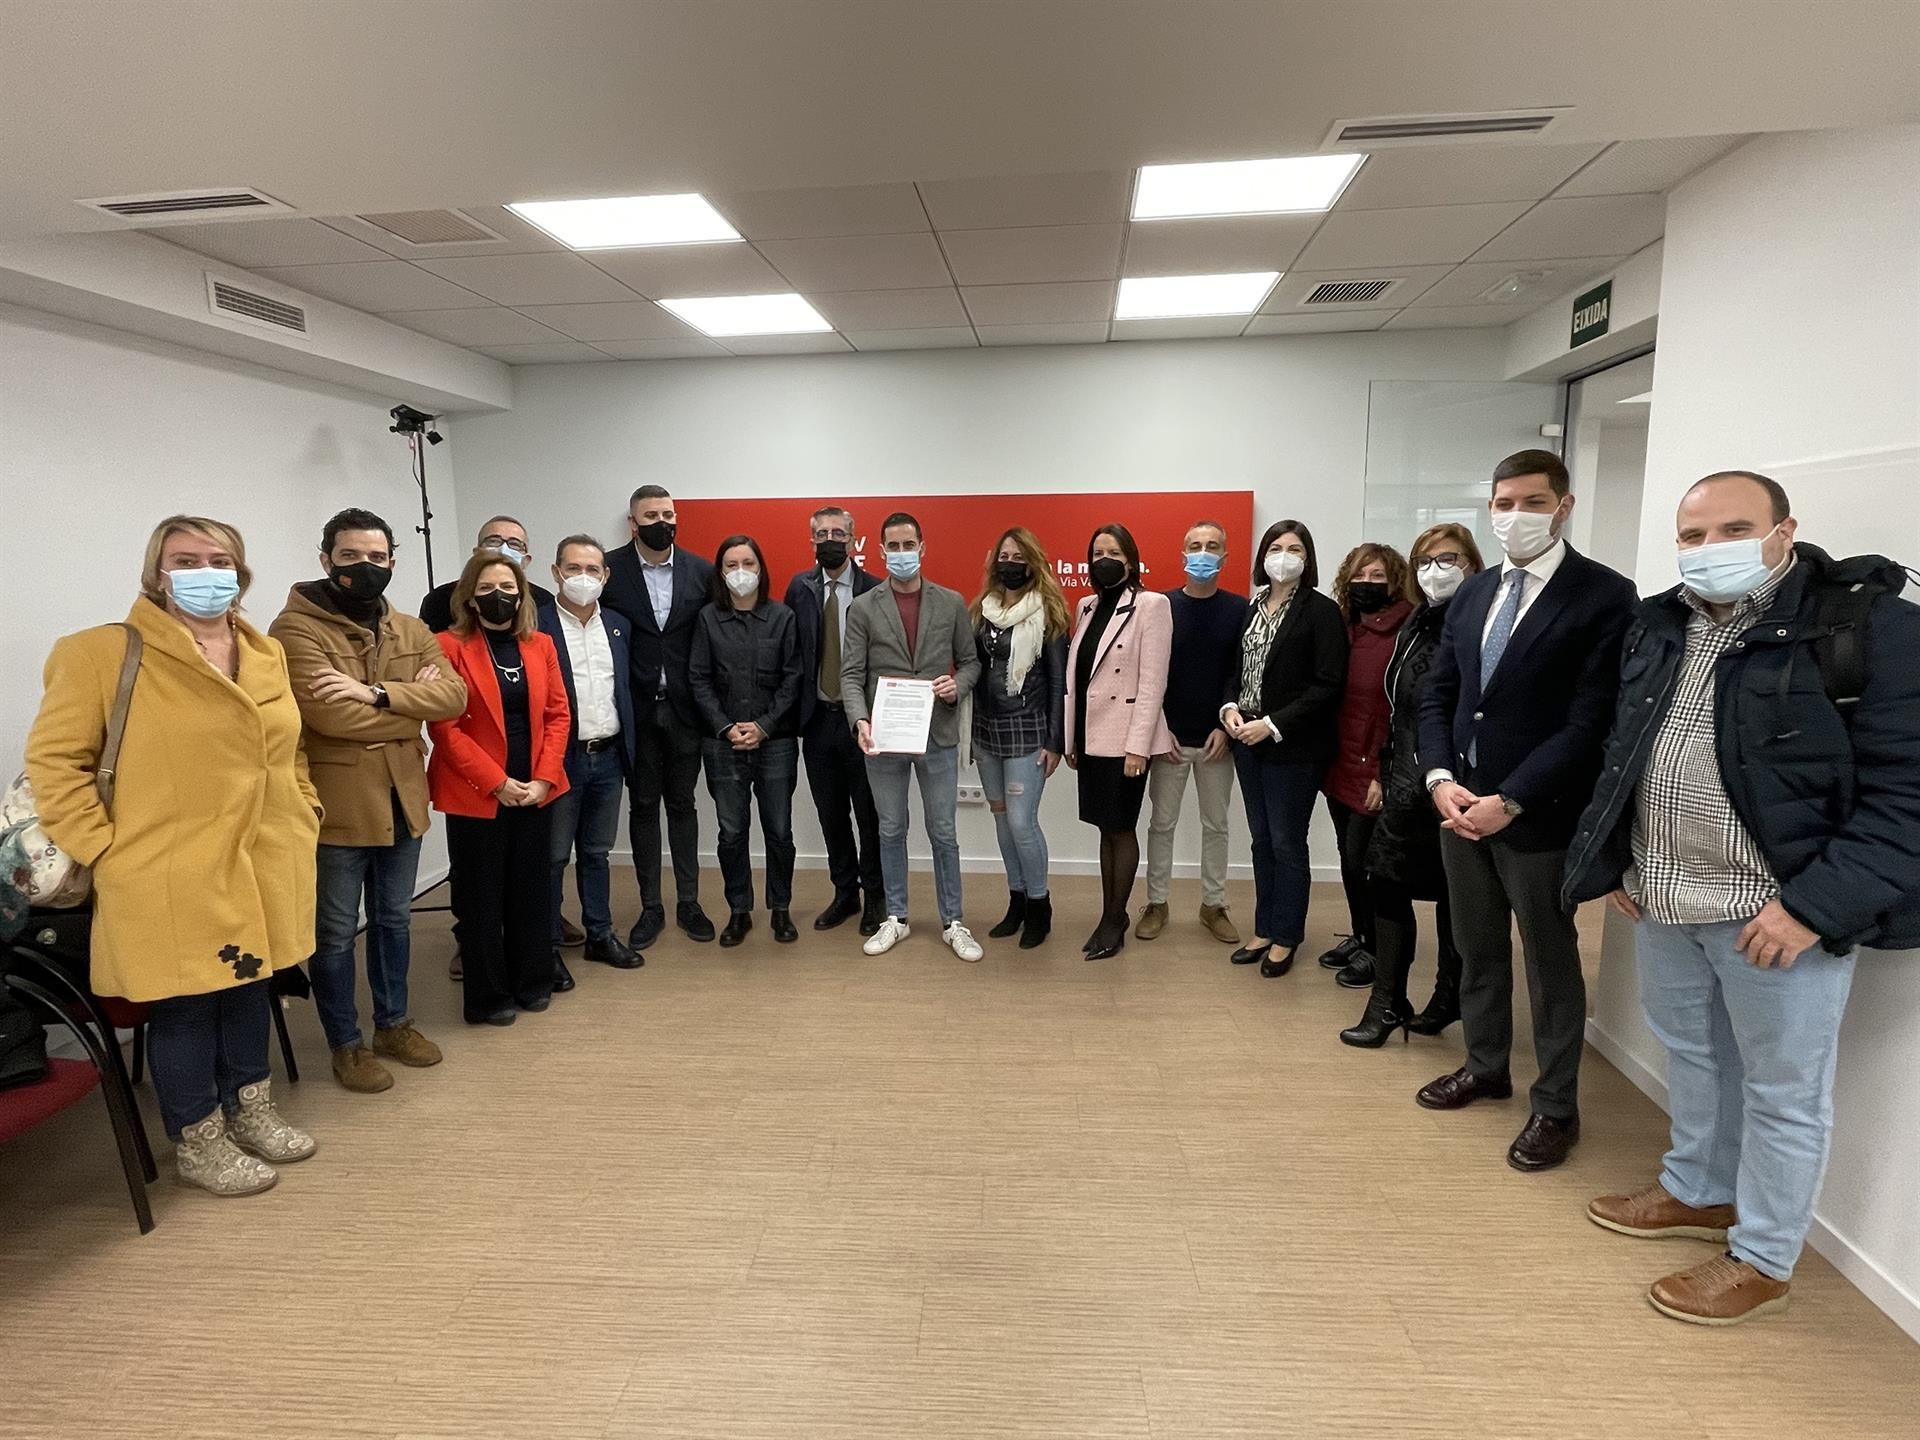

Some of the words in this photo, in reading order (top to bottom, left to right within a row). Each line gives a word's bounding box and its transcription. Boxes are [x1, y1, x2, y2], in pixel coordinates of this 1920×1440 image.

[1573, 298, 1608, 334] EIXIDA
[1057, 559, 1073, 574] la
[1059, 576, 1078, 587] Via
